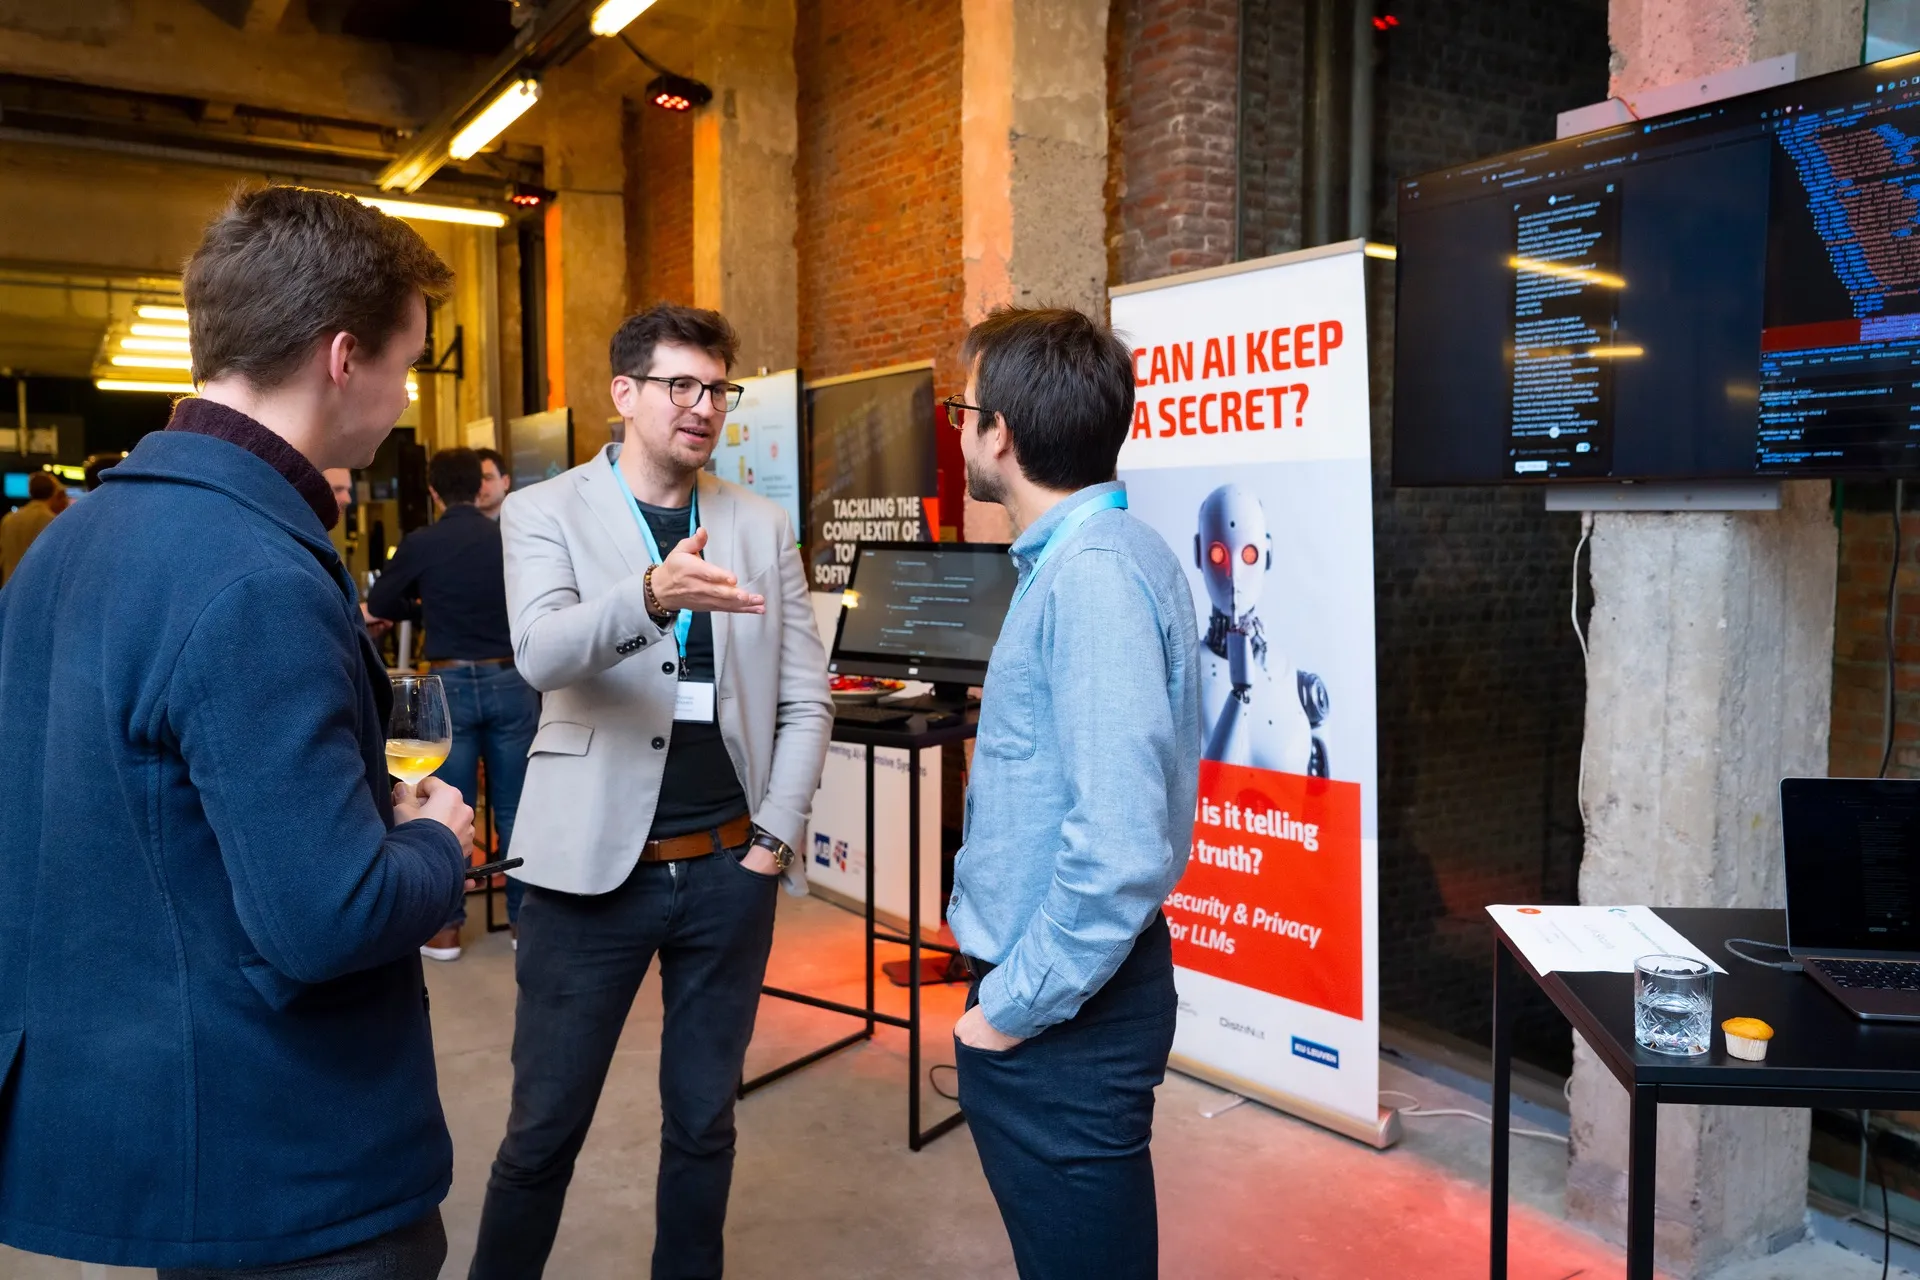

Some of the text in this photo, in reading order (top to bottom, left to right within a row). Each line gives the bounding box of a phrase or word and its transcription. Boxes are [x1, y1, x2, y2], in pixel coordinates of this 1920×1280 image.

[1132, 320, 1344, 388] CAN AI KEEP
[1132, 382, 1310, 440] A SECRET?
[832, 495, 921, 519] TACKLING THE
[822, 519, 921, 542] COMPLEXITY OF
[1202, 797, 1221, 826] is
[1224, 801, 1241, 831] it
[1243, 807, 1319, 852] telling
[1197, 838, 1263, 875] truth?
[1166, 915, 1236, 955] for LLMs
[1233, 903, 1248, 925] &
[1252, 907, 1322, 950] Privacy
